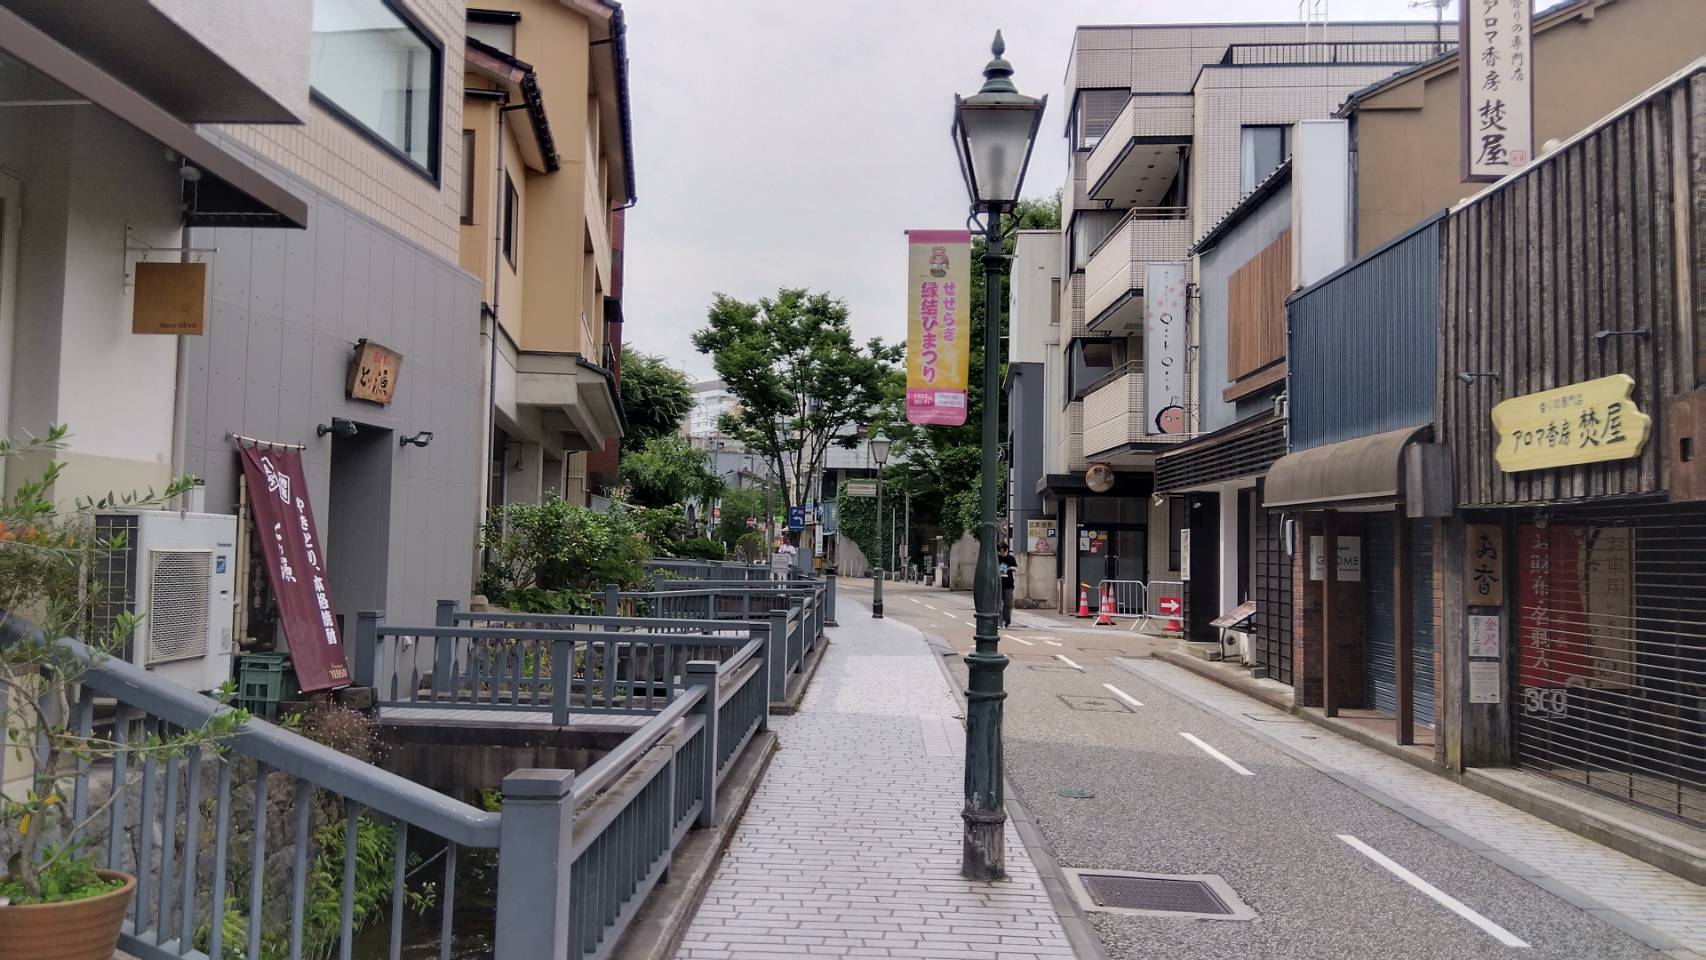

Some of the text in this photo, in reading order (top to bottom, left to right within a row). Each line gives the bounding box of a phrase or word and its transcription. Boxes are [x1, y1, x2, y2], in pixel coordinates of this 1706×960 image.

[920, 281, 938, 384] 縁結びまつり
[942, 281, 956, 342] せせらぎ
[1512, 419, 1571, 454] アロマ香房
[1473, 534, 1498, 595] お香
